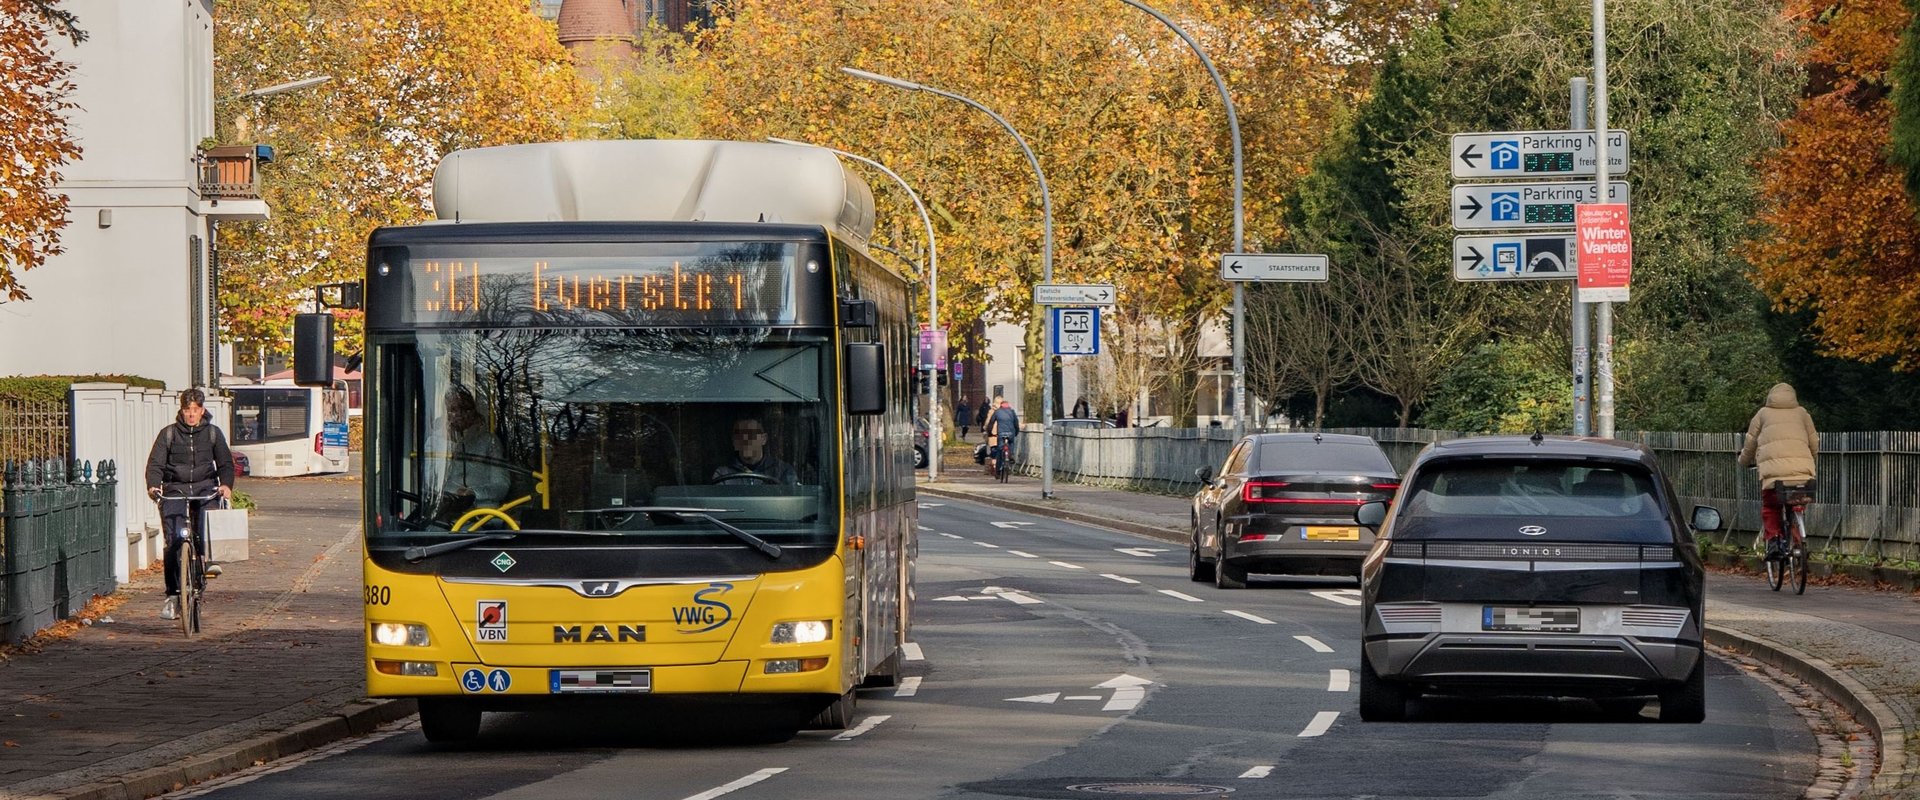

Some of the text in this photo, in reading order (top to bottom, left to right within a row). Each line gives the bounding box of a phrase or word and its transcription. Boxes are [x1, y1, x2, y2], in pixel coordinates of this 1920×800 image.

[1523, 135, 1622, 151] Parkring Nrd
[1524, 153, 1573, 172] 976
[1524, 185, 1616, 202] Parkring Sd
[1526, 204, 1573, 222] 833
[1582, 226, 1627, 240] Winter
[1582, 240, 1629, 255] Varieté
[1063, 315, 1089, 330] P+R
[1067, 333, 1084, 344] City
[496, 558, 512, 566] CNG
[672, 606, 715, 625] VWG
[479, 629, 507, 641] VBN
[553, 624, 647, 643] MAN
